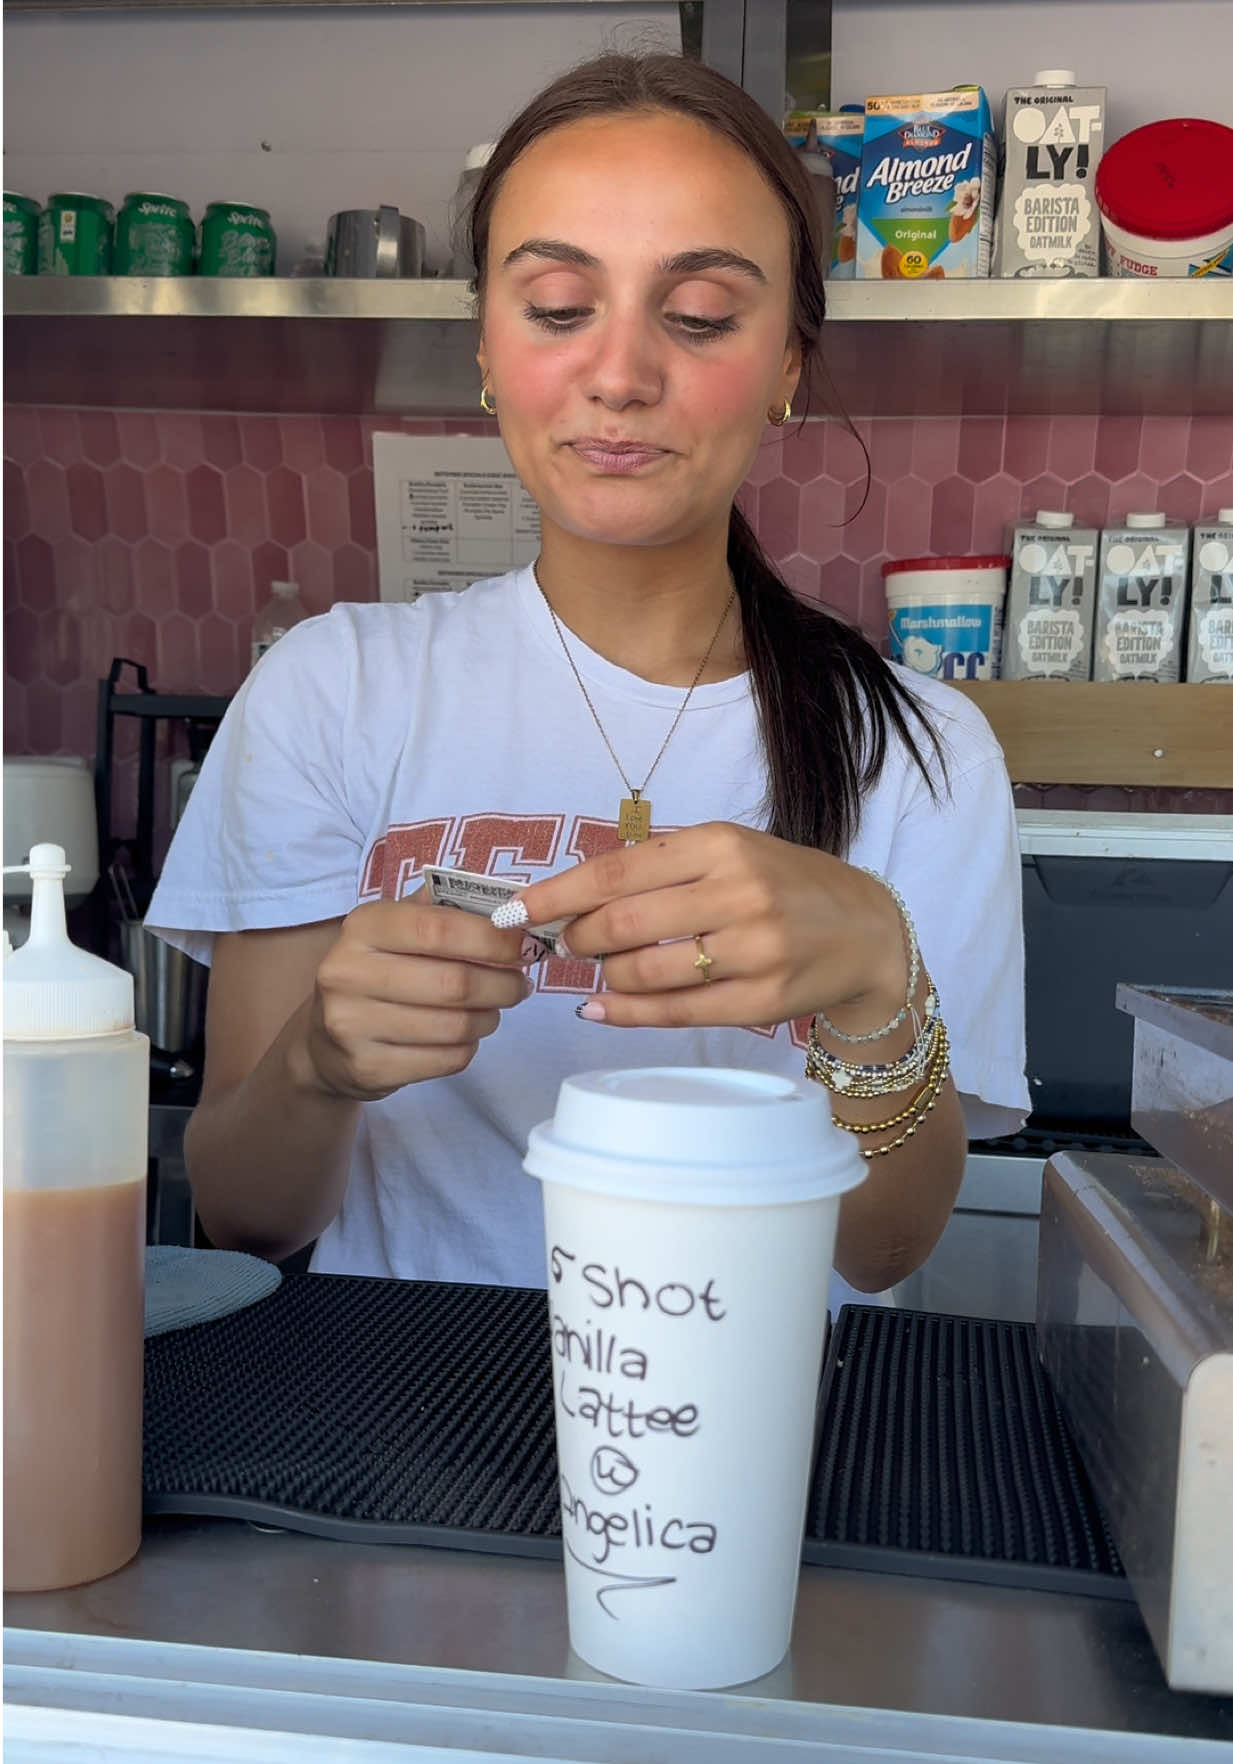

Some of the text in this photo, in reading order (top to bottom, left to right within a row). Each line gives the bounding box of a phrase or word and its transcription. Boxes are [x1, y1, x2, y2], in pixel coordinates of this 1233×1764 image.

[1014, 96, 1074, 104] THE ORIGINAL
[866, 142, 973, 188] Almond
[1026, 144, 1089, 180] LY!
[886, 173, 955, 204] Breeze
[138, 202, 177, 217] Sprite
[1024, 197, 1080, 215] BARISTA
[227, 211, 263, 229] Sprite
[1026, 216, 1078, 233] EDITION
[895, 230, 937, 241] Original
[1029, 236, 1072, 249] OATMILK
[906, 256, 922, 265] 60
[1120, 255, 1158, 276] FUDGE
[1029, 576, 1084, 606] LY!
[1117, 576, 1173, 606] LY!
[901, 616, 982, 629] Marshmallow
[1027, 620, 1075, 635] BARISTA
[1029, 636, 1072, 650] EDITION
[1117, 637, 1162, 651] EDITION
[582, 1264, 727, 1321] Shot
[553, 1315, 649, 1381] anilla
